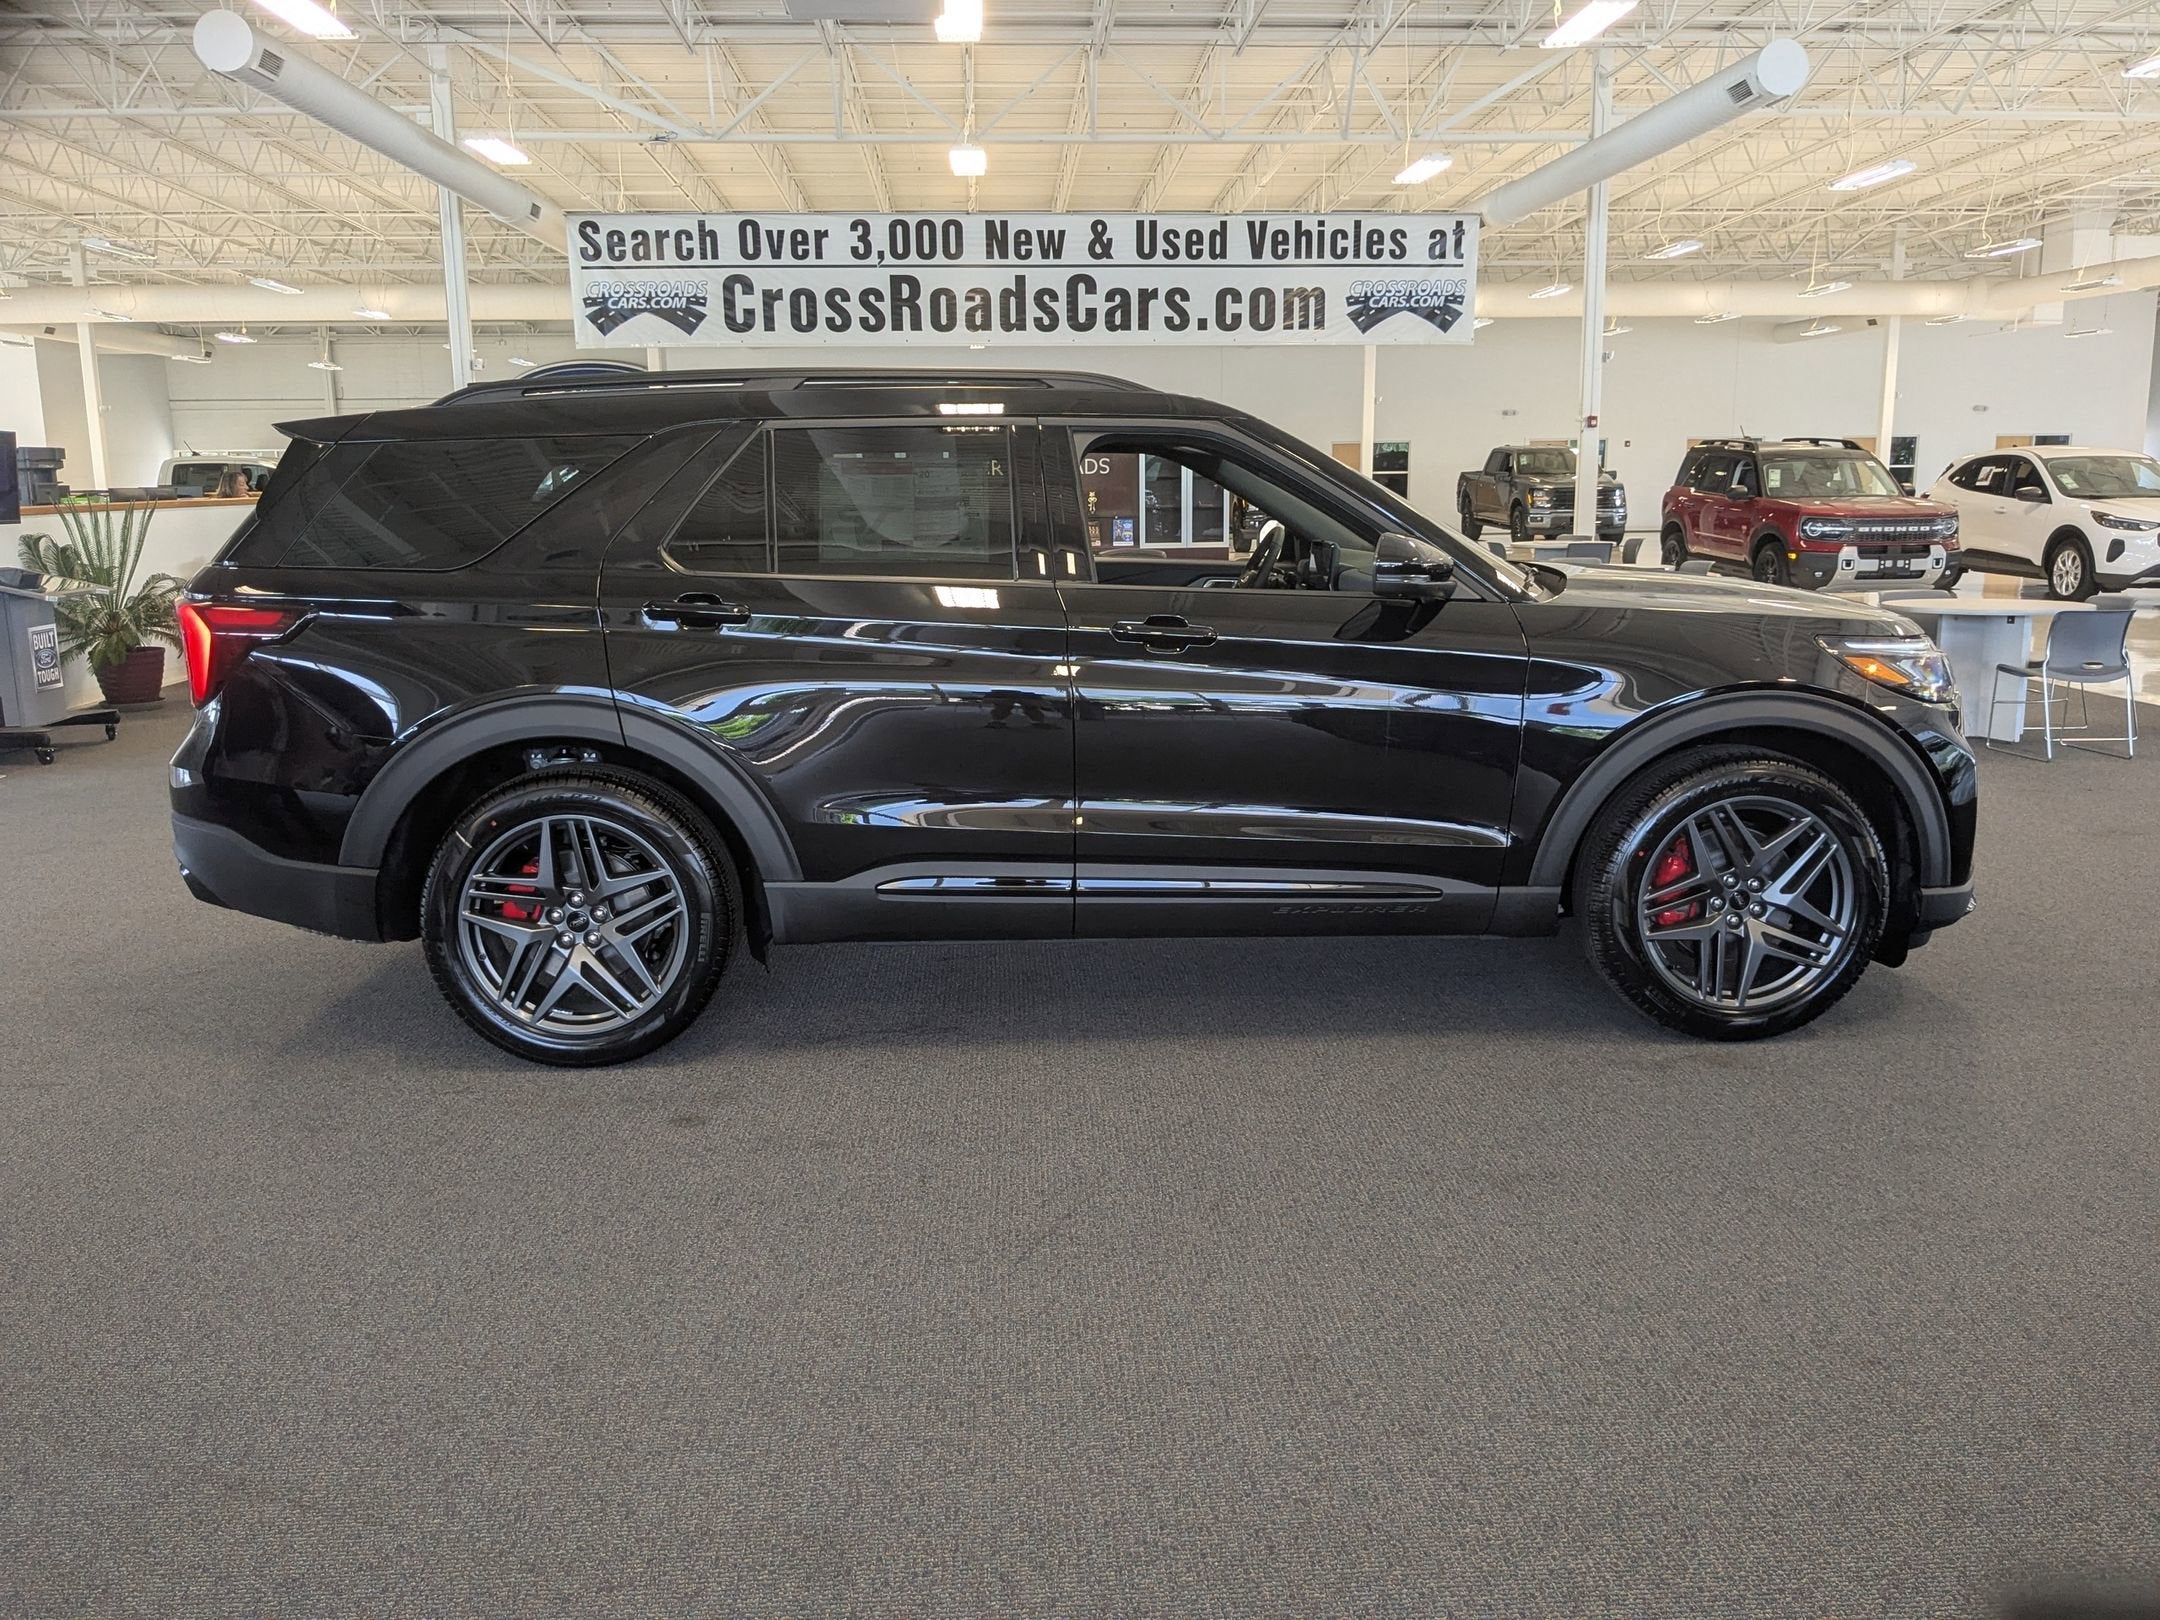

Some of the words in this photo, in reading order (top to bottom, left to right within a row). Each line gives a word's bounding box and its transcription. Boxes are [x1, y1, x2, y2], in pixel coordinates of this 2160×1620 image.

[578, 219, 719, 262] Search
[738, 218, 829, 261] Over
[849, 218, 964, 266] 3,000
[985, 219, 1066, 261] New
[1087, 219, 1114, 261] &
[1135, 219, 1228, 261] Used
[1246, 219, 1408, 261] Vehicles
[1428, 220, 1465, 260] at
[586, 280, 708, 298] CROSSROADS
[1350, 279, 1467, 297] CROSSROADS
[607, 296, 687, 309] CARS.COM
[722, 273, 1326, 334] CrossRoadsCars.com
[1368, 295, 1445, 308] CARS.COM
[33, 632, 54, 650] BUILT
[38, 668, 59, 683] TOUGH
[1272, 905, 1429, 915] EXPLORER
